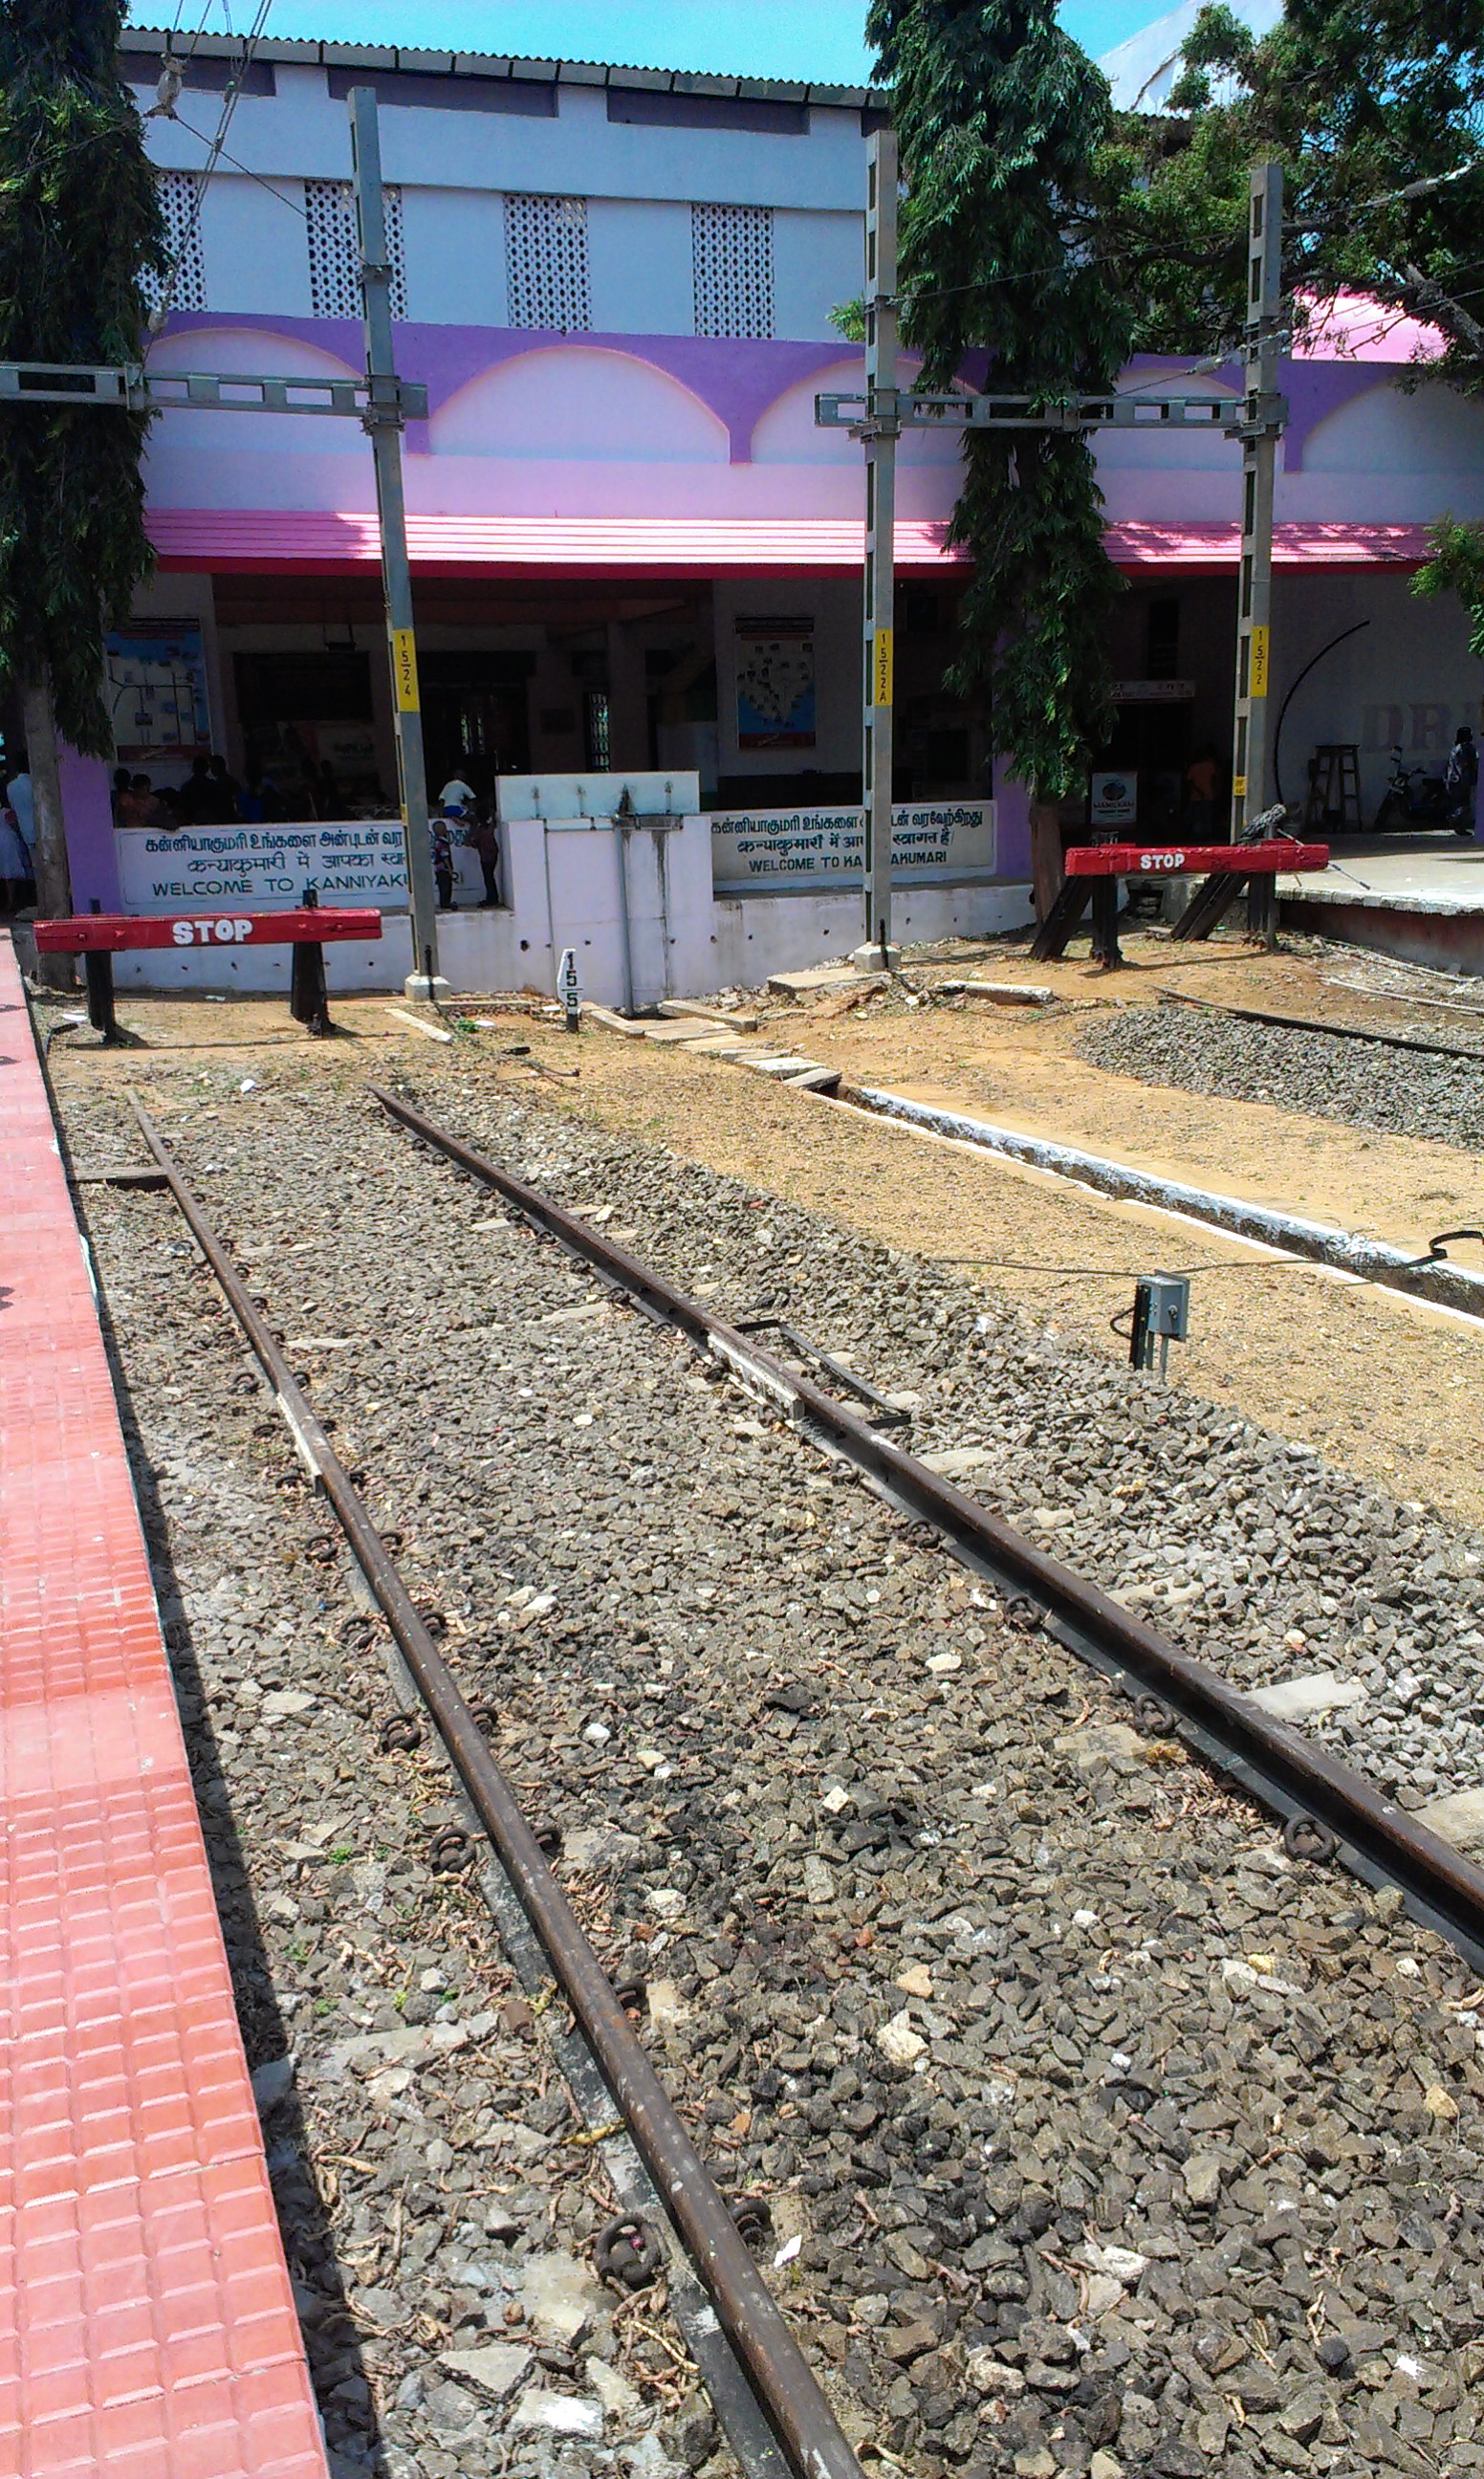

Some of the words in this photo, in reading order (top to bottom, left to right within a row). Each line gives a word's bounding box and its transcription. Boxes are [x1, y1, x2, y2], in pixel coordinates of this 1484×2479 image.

[749, 857, 816, 873] WELCOME
[820, 856, 840, 869] TO
[843, 851, 948, 868] KAAKUMARI
[1140, 852, 1186, 870] STOP
[152, 879, 253, 897] WELCOME
[264, 877, 295, 892] TO
[172, 919, 253, 945] STOP
